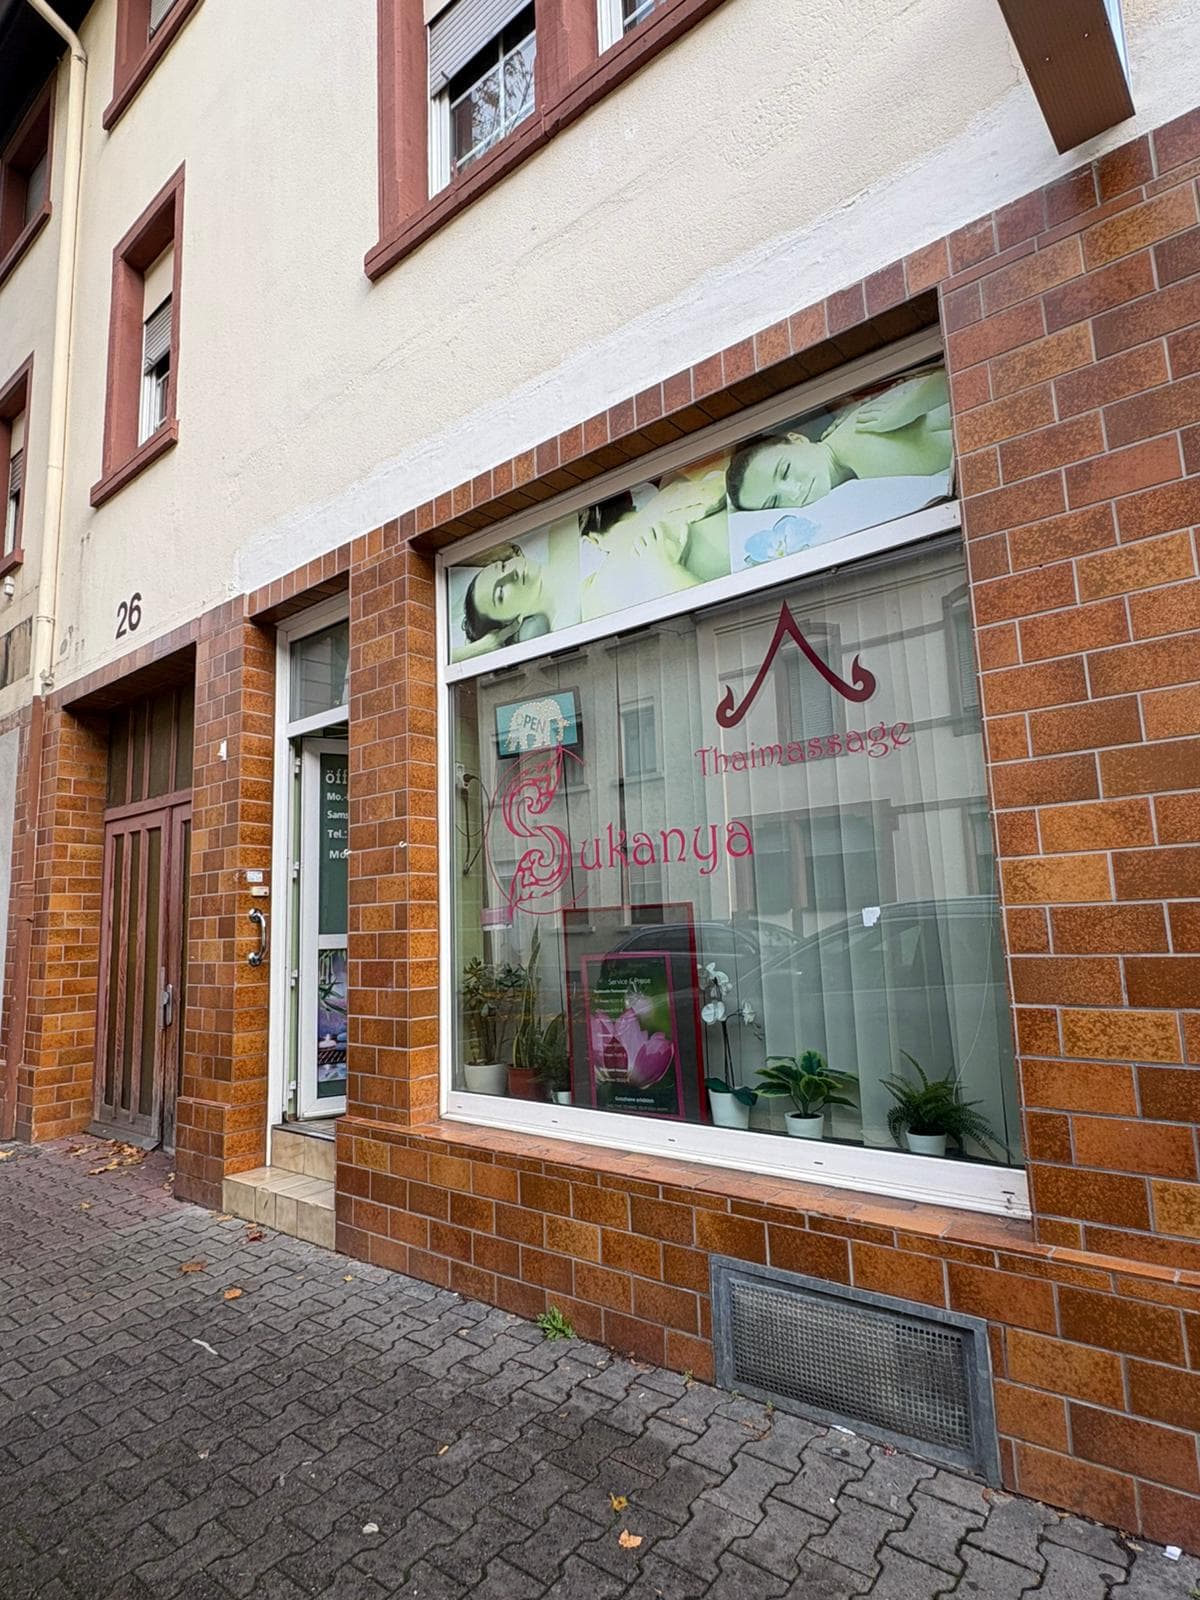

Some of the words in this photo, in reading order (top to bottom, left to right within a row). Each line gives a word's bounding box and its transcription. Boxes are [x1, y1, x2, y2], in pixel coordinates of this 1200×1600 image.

[115, 592, 142, 640] 26
[694, 721, 912, 777] Thaimassage
[326, 791, 348, 801] Mo.-
[329, 849, 348, 860] Mo
[488, 745, 754, 919] Sukanya
